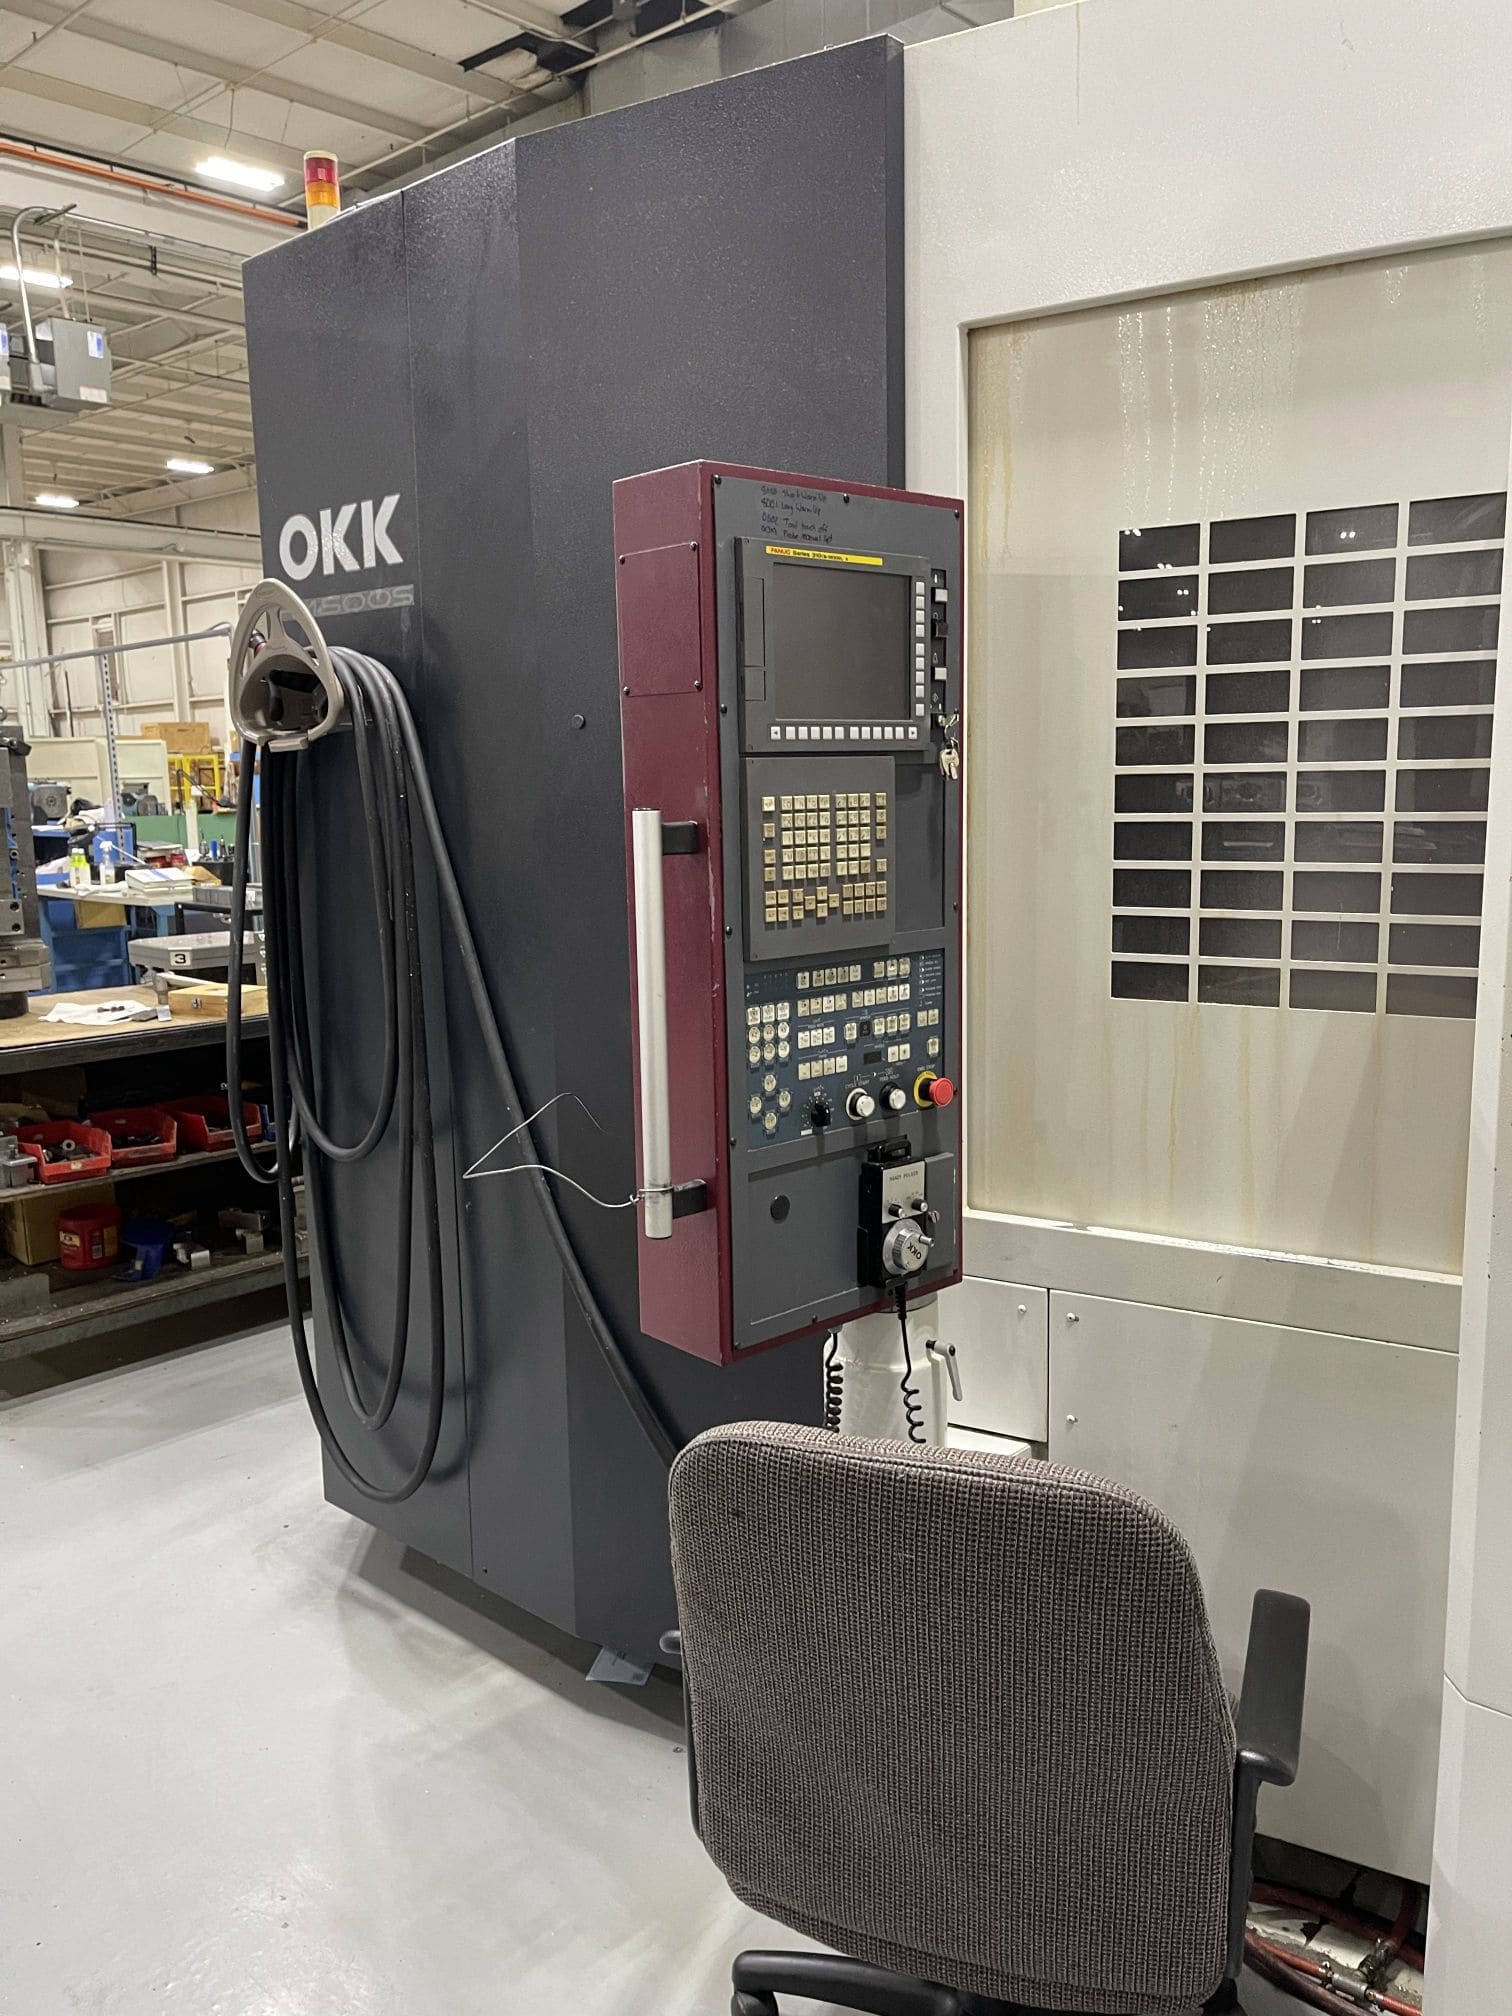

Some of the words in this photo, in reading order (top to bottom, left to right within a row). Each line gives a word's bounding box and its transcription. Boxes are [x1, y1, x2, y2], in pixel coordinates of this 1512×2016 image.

[278, 493, 404, 581] OKK
[770, 547, 791, 555] FANUC
[174, 953, 186, 965] 3
[907, 1242, 922, 1260] OKK
